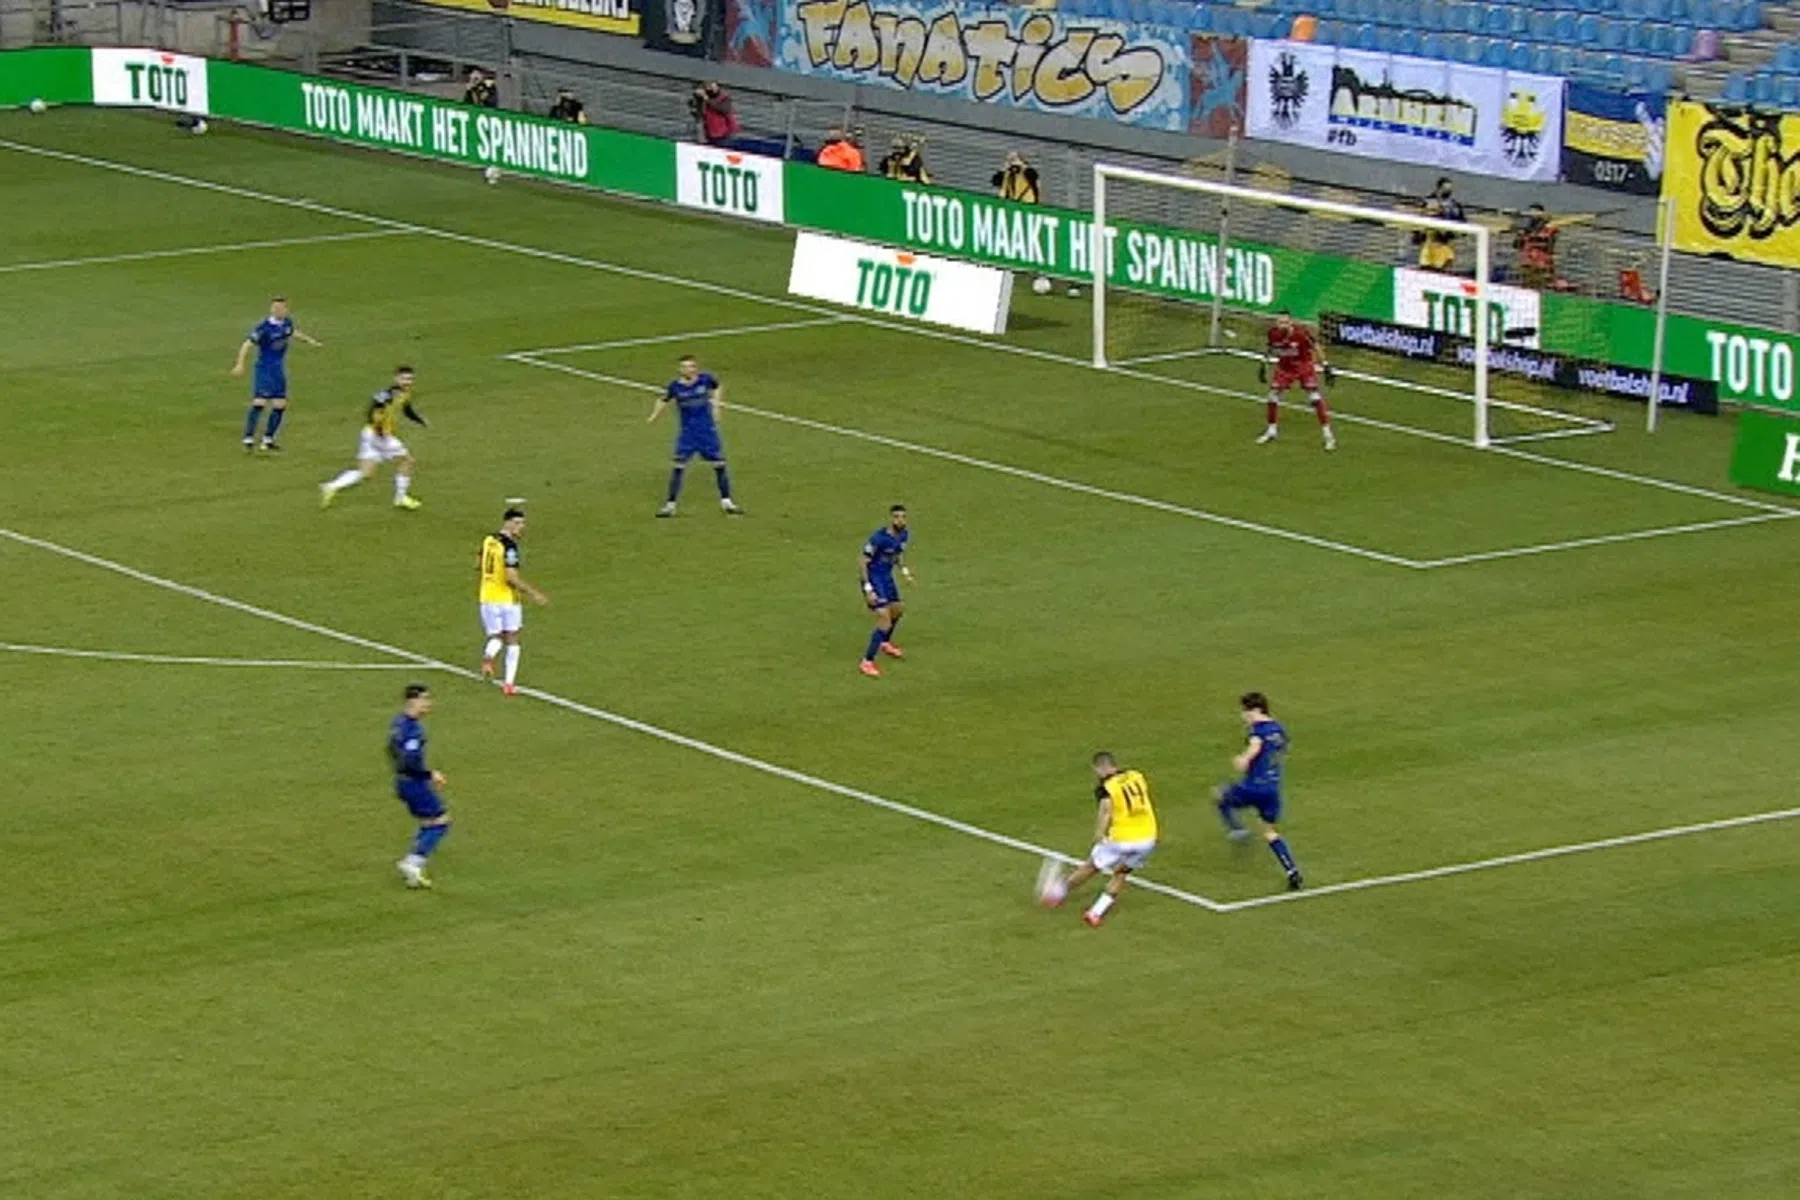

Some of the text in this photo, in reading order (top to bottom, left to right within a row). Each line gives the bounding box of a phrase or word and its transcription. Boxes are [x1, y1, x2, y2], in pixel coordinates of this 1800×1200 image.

[126, 63, 187, 106] TOTO
[302, 83, 588, 178] TOTO MAAKT HET SPANNEND
[698, 160, 759, 212] TOTO
[903, 191, 964, 251] TOTO
[972, 203, 1059, 266] MAAKT
[1127, 230, 1273, 305] SPANNEND
[856, 258, 932, 315] TOTO
[1339, 323, 1435, 356] voetbalshop.nl
[1457, 345, 1556, 379] vobalshop.nl
[1706, 331, 1793, 400] TOTO
[1578, 369, 1689, 403] voetbalshp.nl
